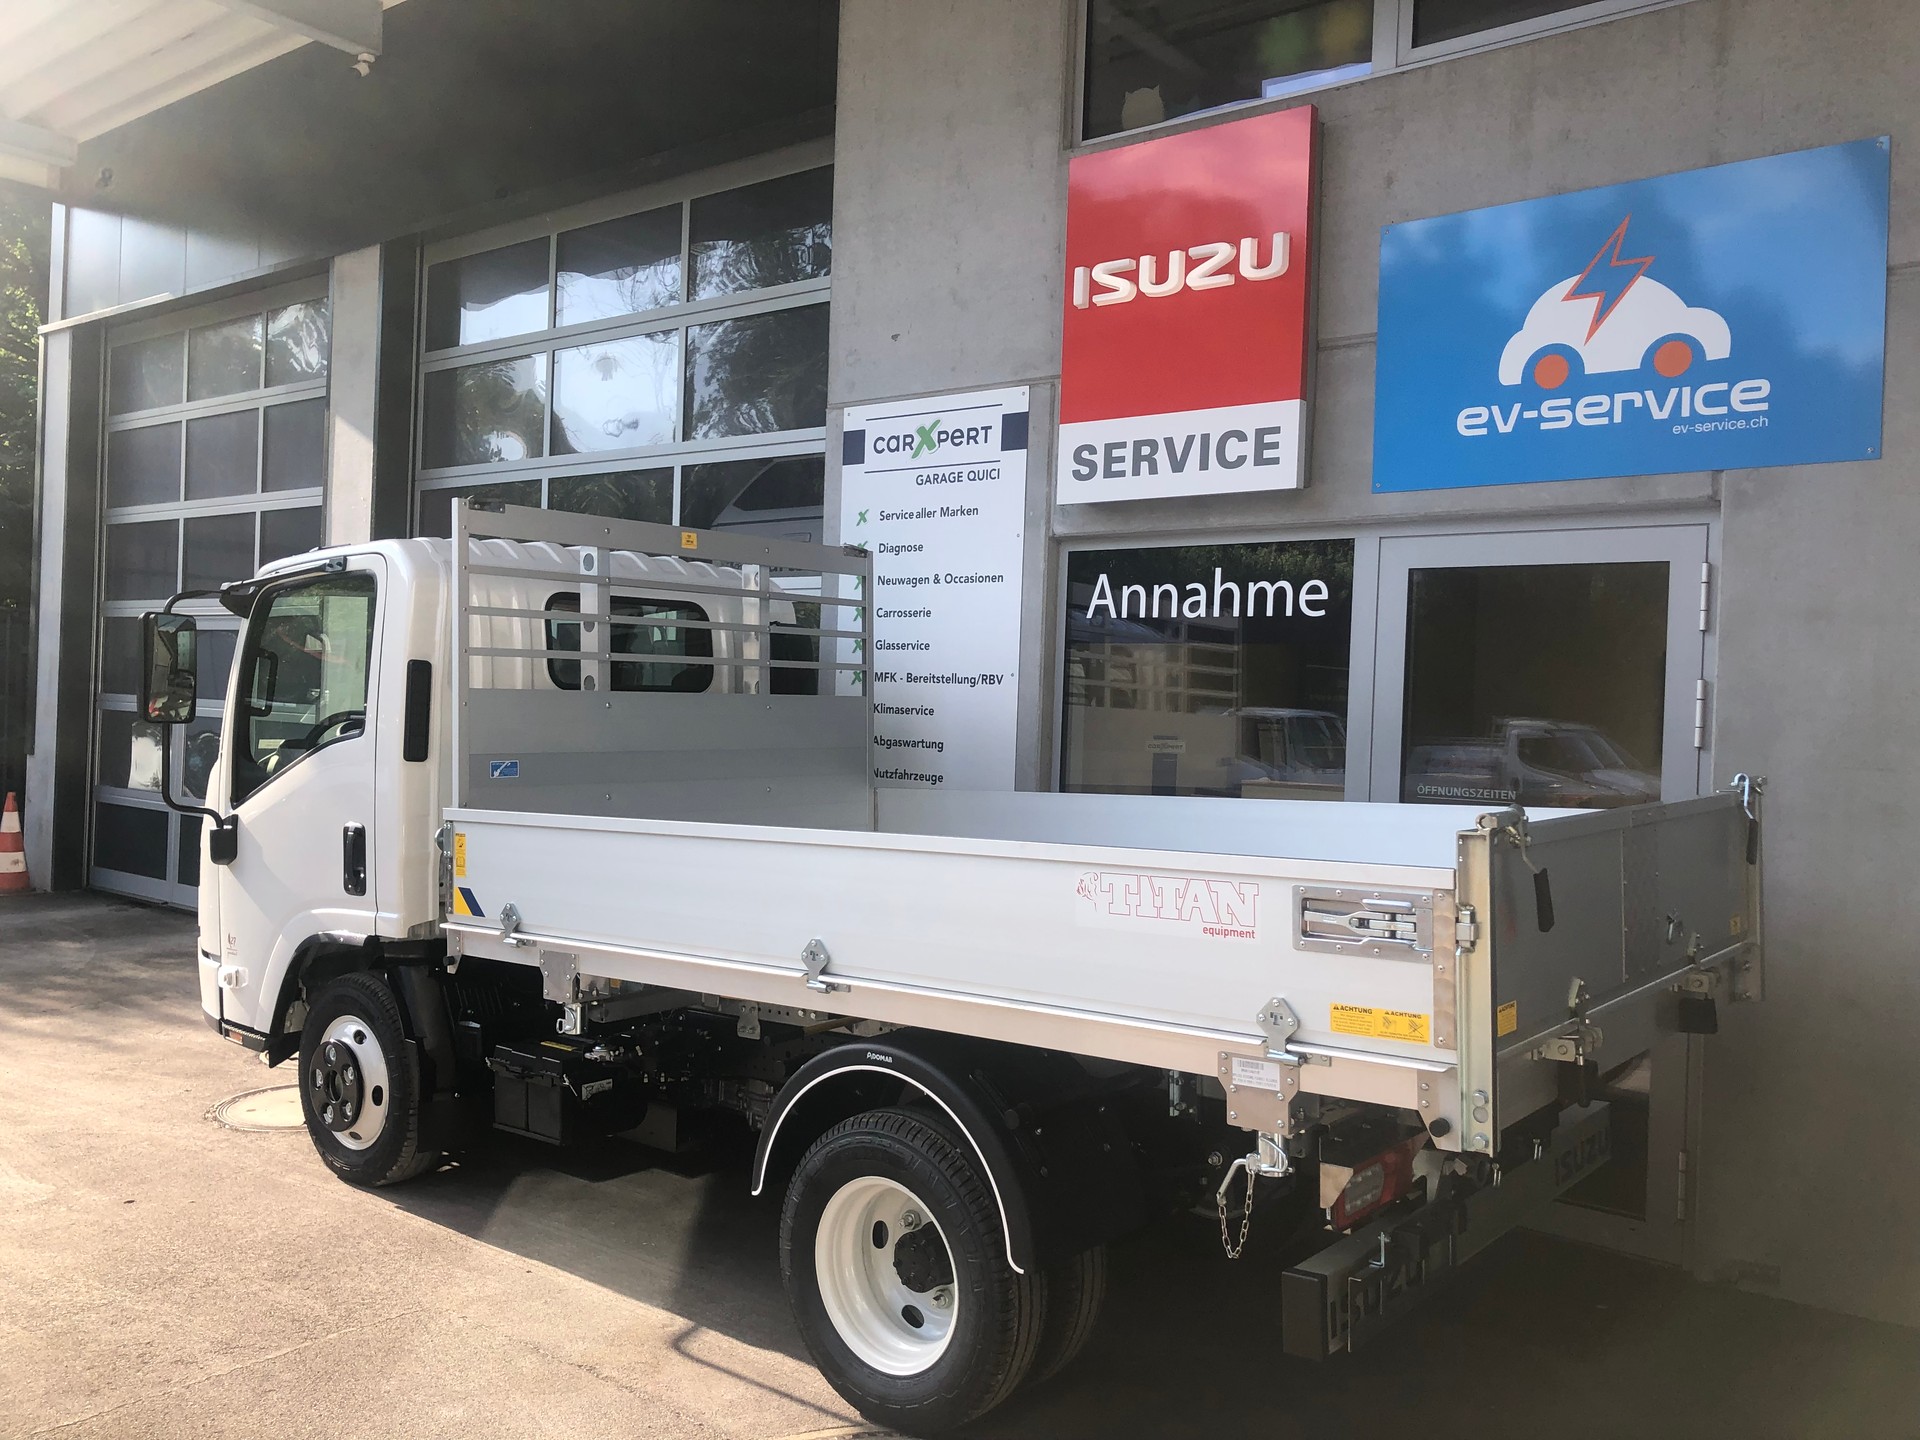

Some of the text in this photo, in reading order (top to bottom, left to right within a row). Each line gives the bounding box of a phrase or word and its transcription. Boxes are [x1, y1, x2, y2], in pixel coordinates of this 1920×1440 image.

[1073, 232, 1290, 309] ISUZU
[1457, 378, 1771, 436] ev-service
[1672, 416, 1768, 436] ev-service.ch
[1071, 425, 1281, 482] SERVICE
[915, 468, 1000, 486] GARAGE QUICI
[879, 505, 979, 521] Service aller Marken
[878, 542, 924, 556] Diagnose
[877, 572, 1004, 589] Neuwagen & Occasionen
[1086, 567, 1329, 619] Annahme
[876, 607, 932, 618] Carrosserie
[875, 639, 931, 651] Glasservice
[874, 672, 897, 683] MFK
[906, 672, 1004, 687] Bereitstellung/RBV
[873, 703, 935, 716] Klimaservice
[873, 735, 944, 752] Abgaswartung
[1416, 783, 1517, 800] ÖFFNUNGSZEITEN
[1100, 872, 1260, 928] TITAN
[1202, 925, 1256, 939] equipment
[1340, 1005, 1373, 1014] ACHTUNG
[1390, 1011, 1422, 1019] ACHTUNG
